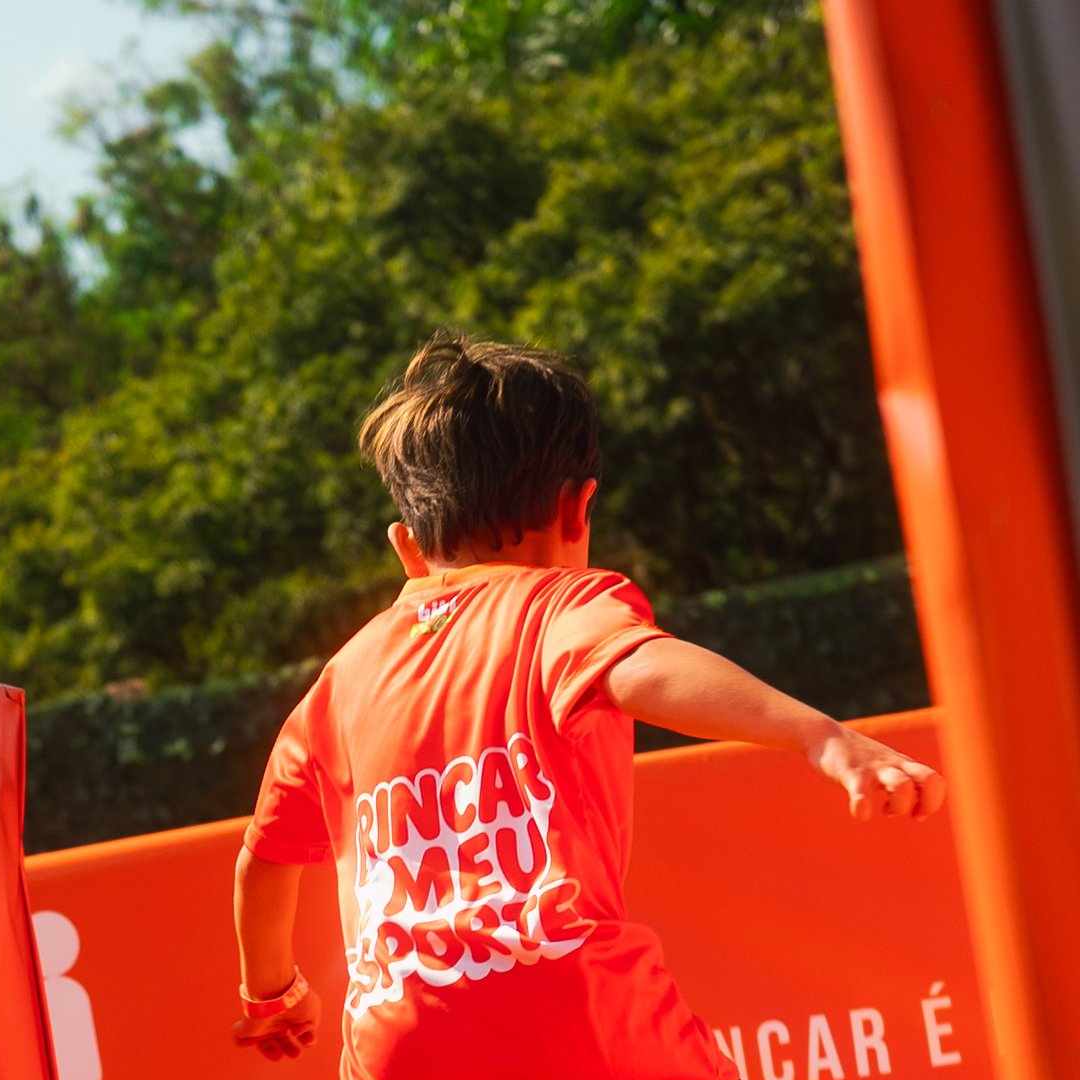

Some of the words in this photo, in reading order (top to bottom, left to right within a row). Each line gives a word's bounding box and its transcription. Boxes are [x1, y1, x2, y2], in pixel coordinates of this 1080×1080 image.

[382, 817, 548, 917] MEU
[347, 879, 597, 1012] SPORTE
[921, 980, 962, 1068] É
